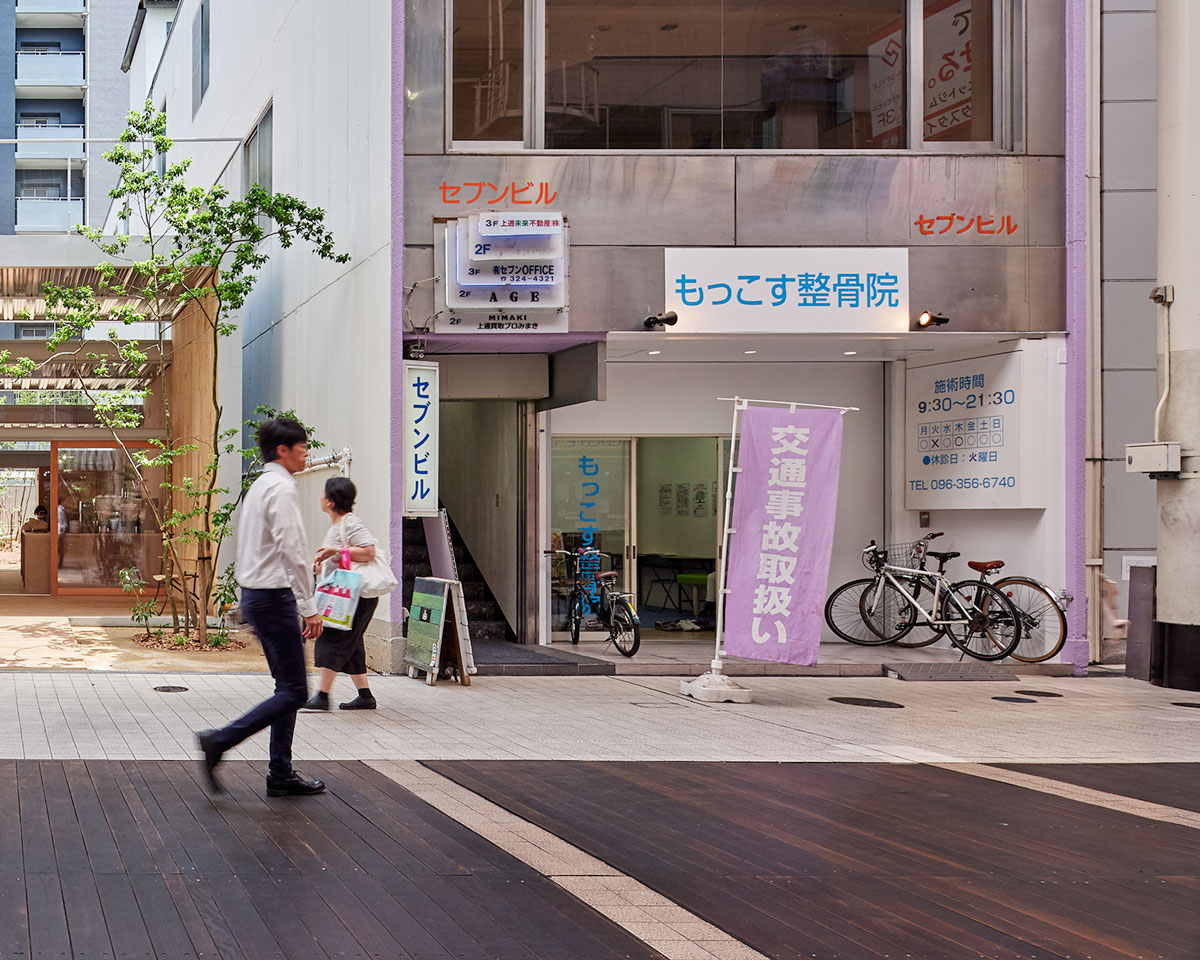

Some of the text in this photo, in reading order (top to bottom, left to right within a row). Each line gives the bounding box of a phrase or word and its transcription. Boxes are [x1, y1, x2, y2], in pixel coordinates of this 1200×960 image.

[438, 181, 558, 205] セブンビル
[485, 219, 498, 227] 3F
[914, 213, 1018, 235] セブンビル
[474, 244, 491, 255] 2F
[459, 290, 471, 298] 2F
[674, 272, 899, 308] もっこす整骨院
[449, 317, 461, 325] 2F
[934, 374, 985, 394] 施術時間
[920, 419, 1000, 436] 月 火 水 木 金 土 日
[411, 377, 431, 501] セブンビル
[909, 476, 1016, 490] TEL 096-356-6740
[751, 425, 810, 644] 交通事故取扱い
